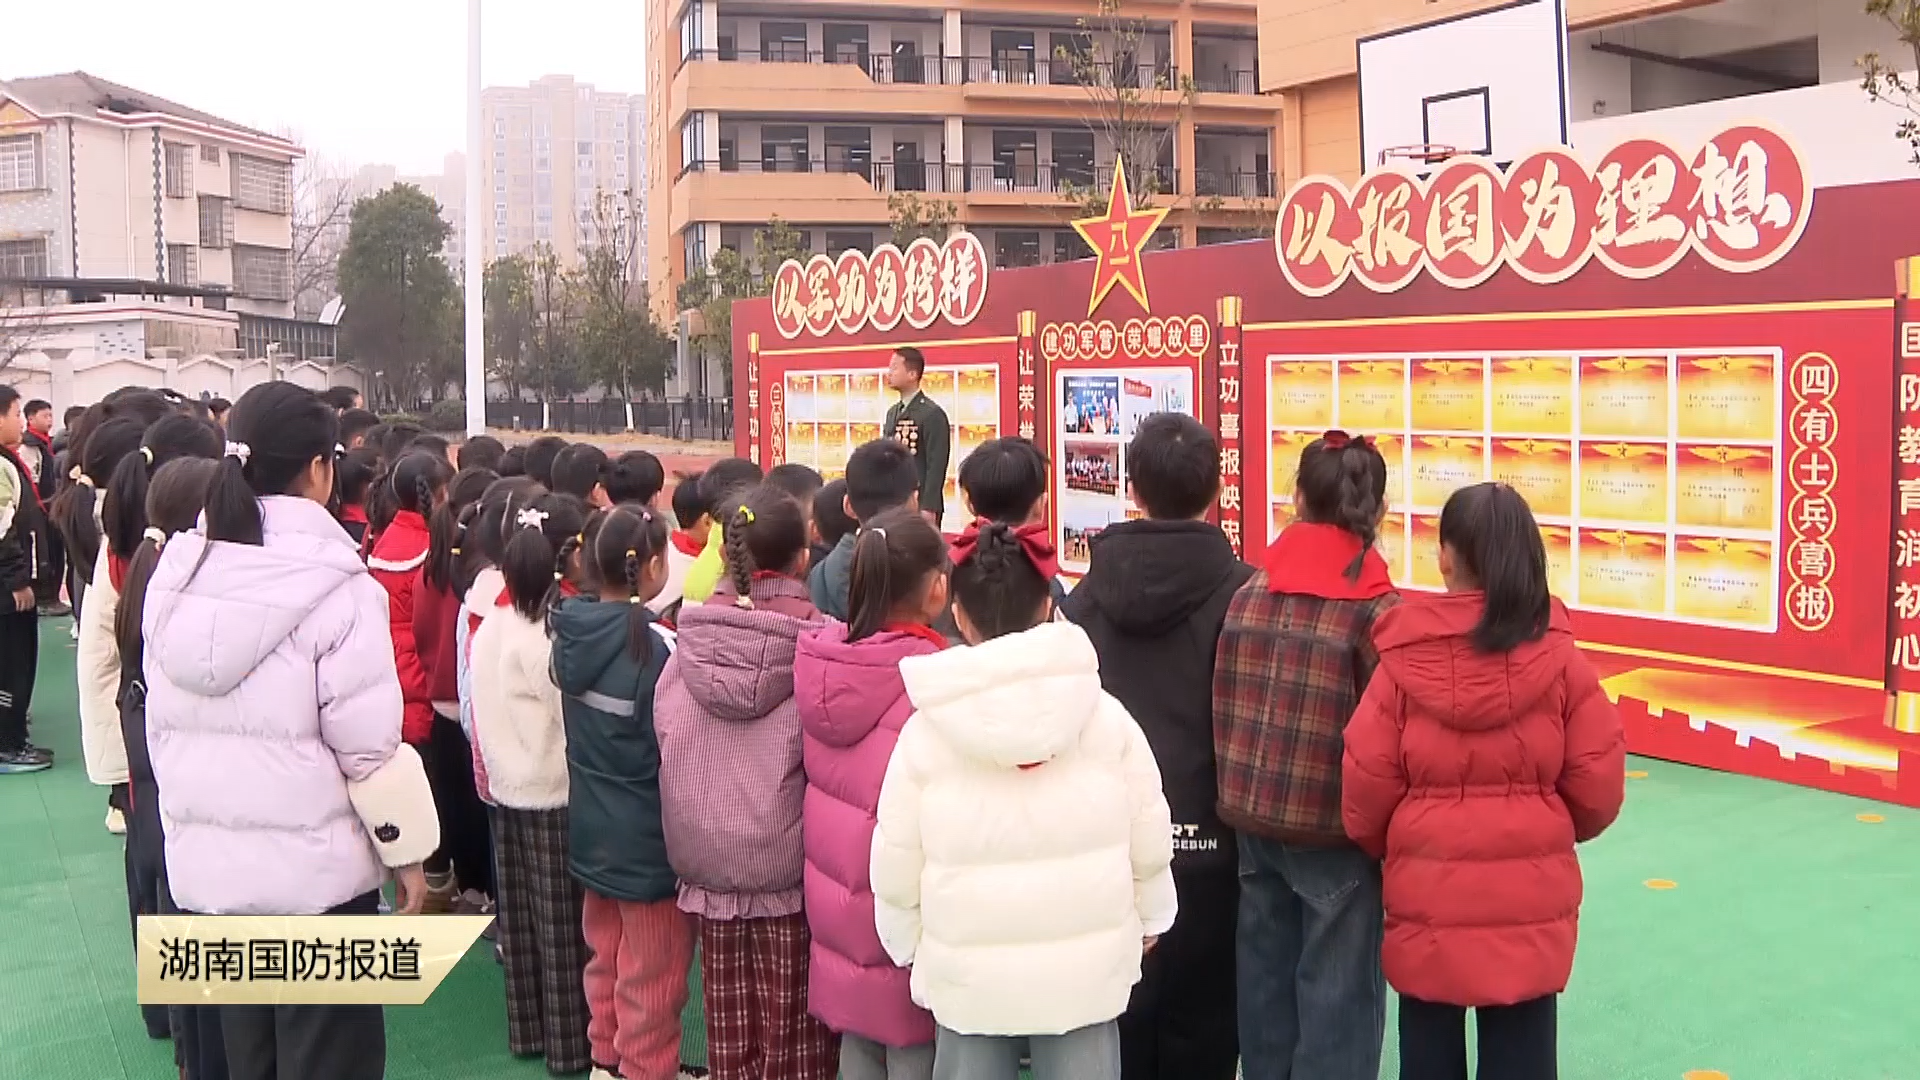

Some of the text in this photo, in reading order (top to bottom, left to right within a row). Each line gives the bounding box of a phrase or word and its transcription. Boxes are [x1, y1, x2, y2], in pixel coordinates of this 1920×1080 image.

[1109, 220, 1130, 265] 八一
[1286, 139, 1792, 276] 以报国为理想
[777, 239, 977, 326] 以军功为榜样
[1219, 340, 1241, 561] 立功喜报映忠
[1794, 364, 1832, 623] 四有士兵喜报
